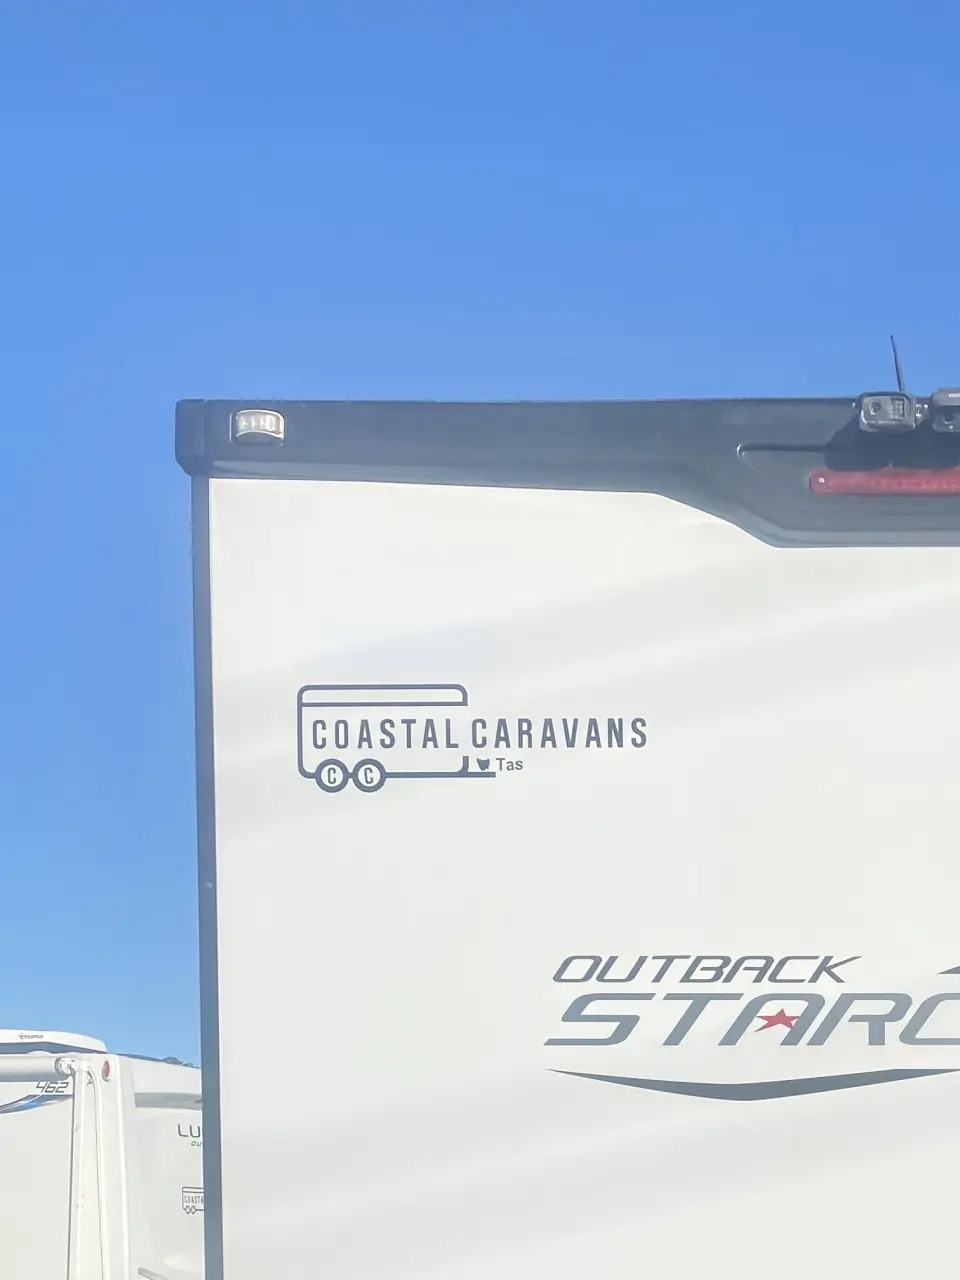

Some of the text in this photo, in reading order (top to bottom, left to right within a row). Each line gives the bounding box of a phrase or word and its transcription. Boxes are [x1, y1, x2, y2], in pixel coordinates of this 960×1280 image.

[312, 717, 647, 749] COASTAL CARAVANS
[496, 757, 524, 771] Tas
[552, 955, 863, 984] OUTBACK
[35, 1081, 70, 1093] 462
